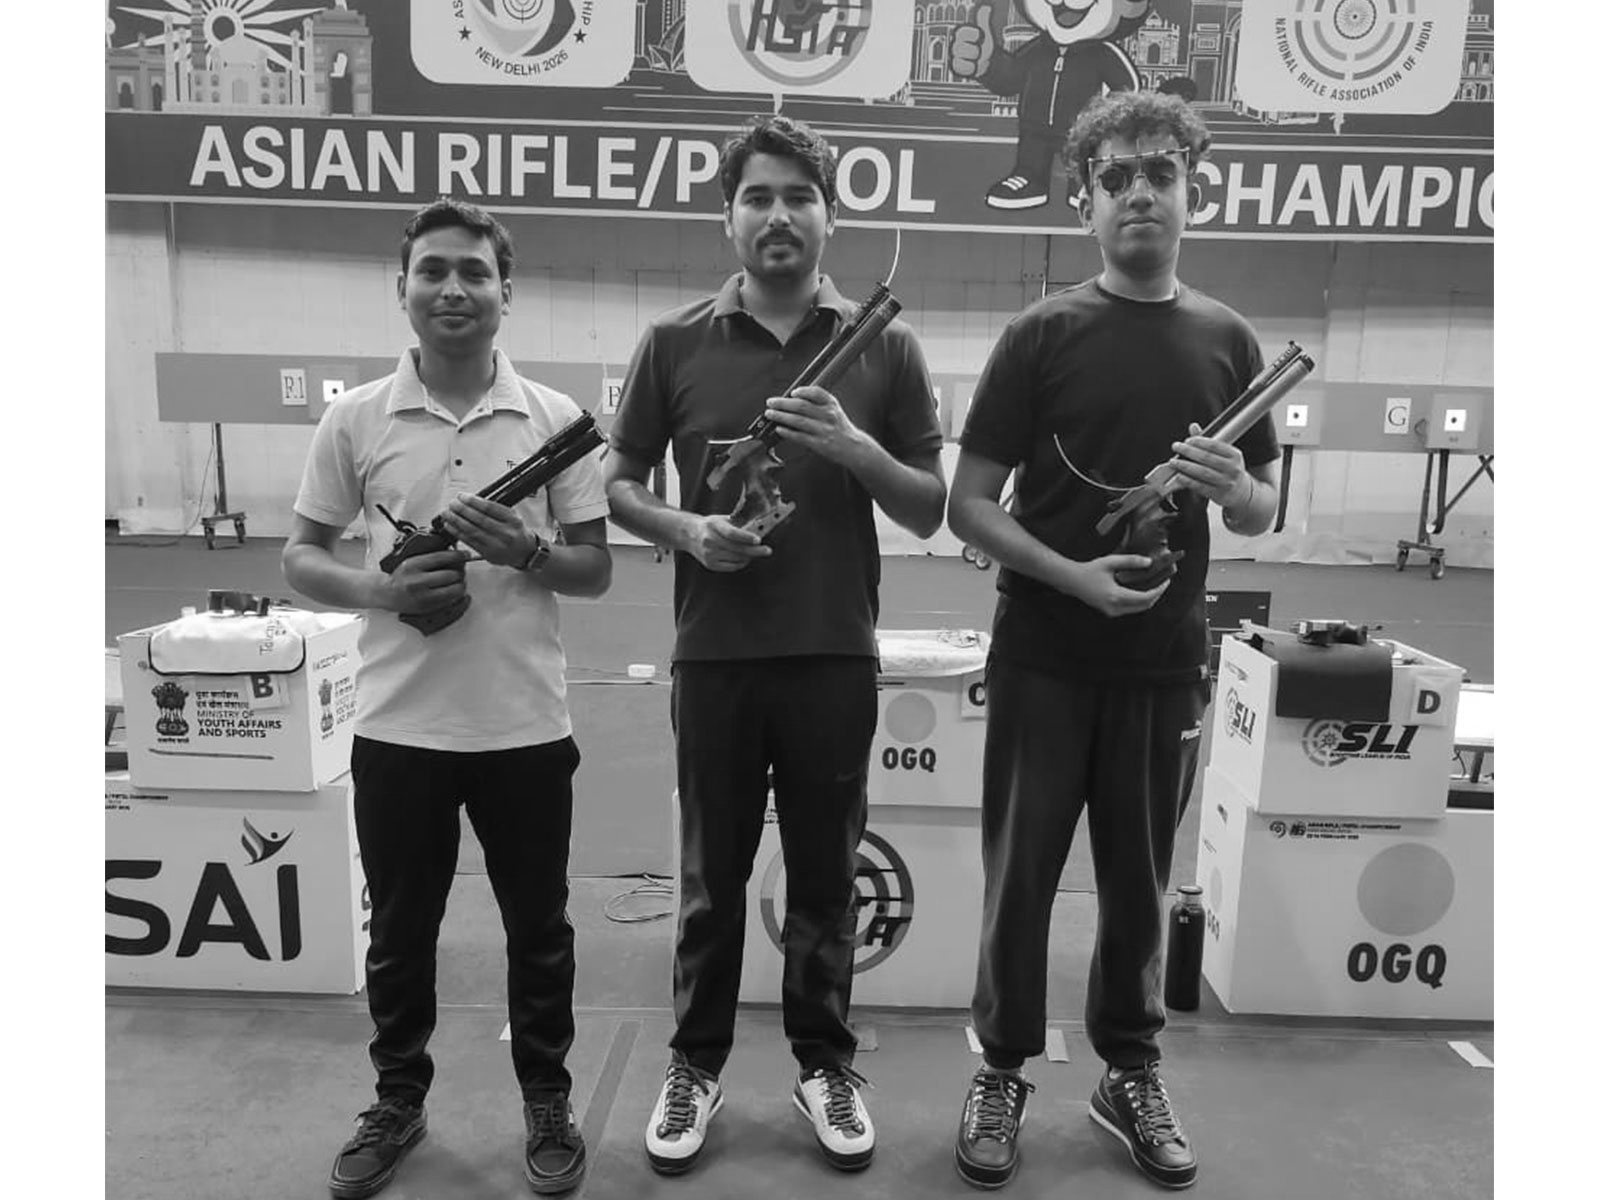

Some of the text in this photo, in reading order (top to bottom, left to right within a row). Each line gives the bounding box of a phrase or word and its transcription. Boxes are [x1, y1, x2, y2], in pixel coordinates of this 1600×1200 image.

[475, 46, 569, 76] NEW DELHI 2026
[1275, 17, 1434, 101] NATIONAL RIFLE ASSOCIATION OF INDIA
[189, 124, 415, 193] ASIAN
[1388, 405, 1407, 427] G
[250, 674, 273, 698] B
[197, 710, 254, 719] MINISTRY OF
[1417, 689, 1441, 714] D
[197, 718, 283, 729] YOUTH AFFAIRS
[198, 728, 267, 738] AND SPORTS
[1232, 701, 1256, 739] SLI
[1333, 724, 1420, 754] SLI
[882, 747, 937, 773] OGQ
[105, 859, 302, 961] SAI
[1347, 942, 1447, 989] OGQ
